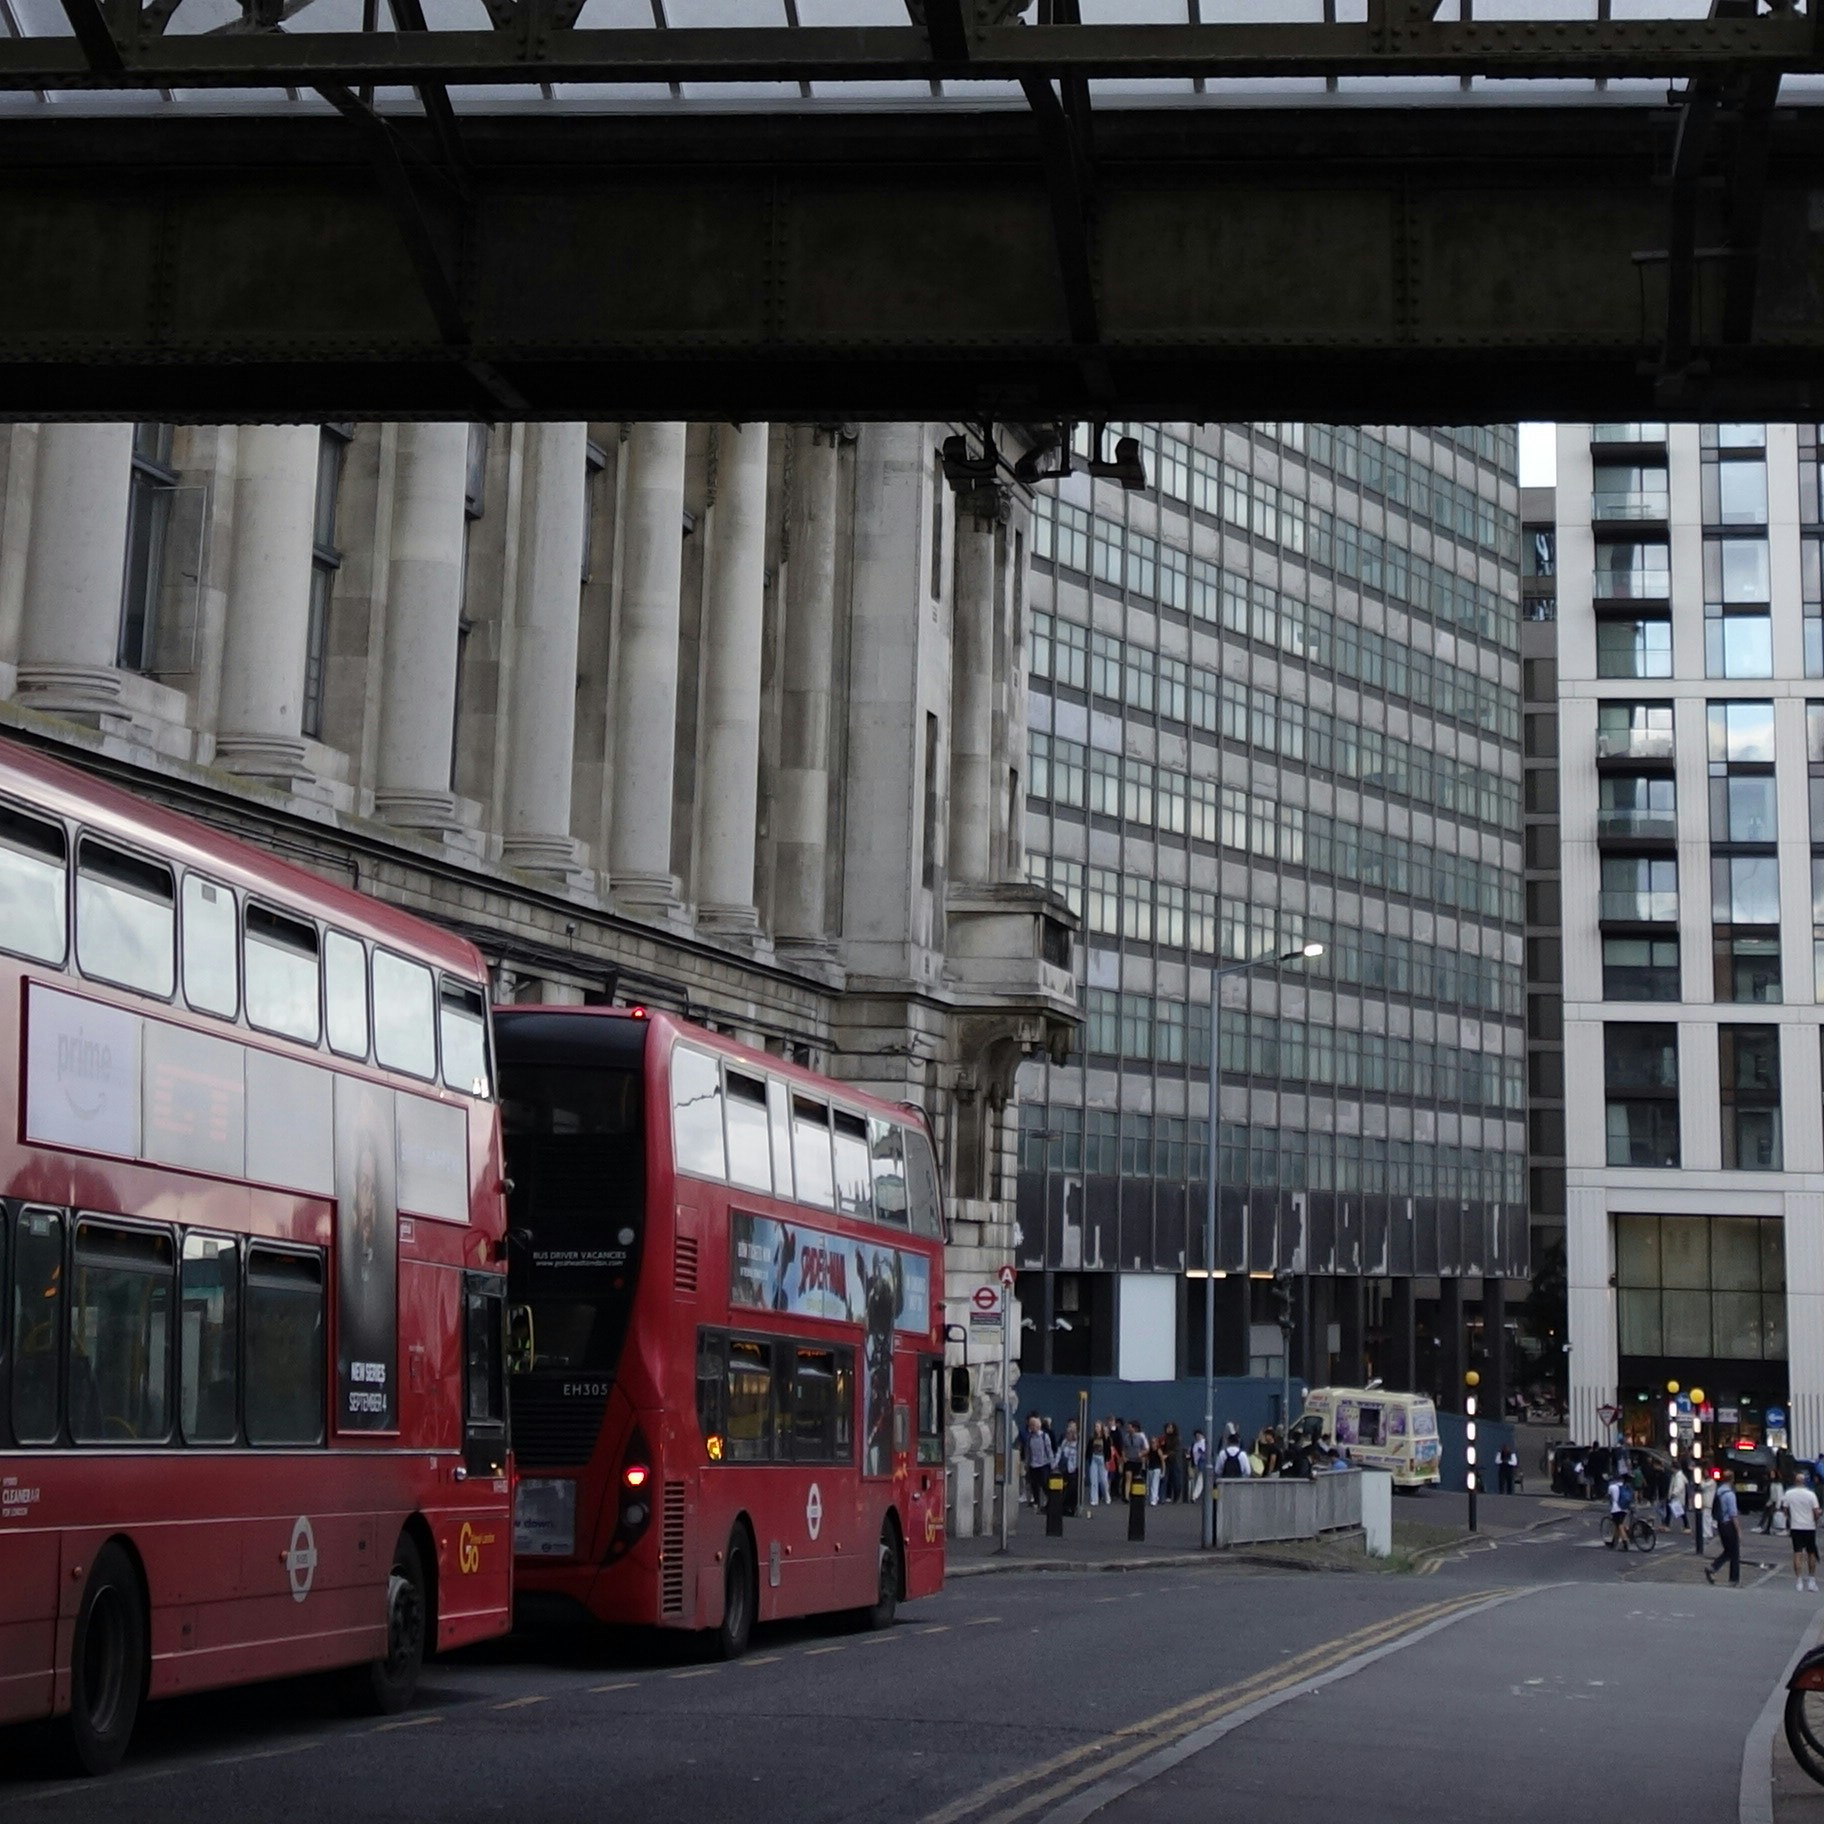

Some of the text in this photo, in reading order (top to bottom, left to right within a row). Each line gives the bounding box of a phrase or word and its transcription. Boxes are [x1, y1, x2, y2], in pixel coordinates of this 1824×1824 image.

[533, 1251, 627, 1260] BUS DRIVER VACANCIES
[1001, 1267, 1014, 1283] A
[350, 1361, 387, 1383] NEW SERIES
[562, 1383, 609, 1397] EH305
[348, 1391, 383, 1413] SEPTEMBER
[459, 1522, 480, 1574] Go
